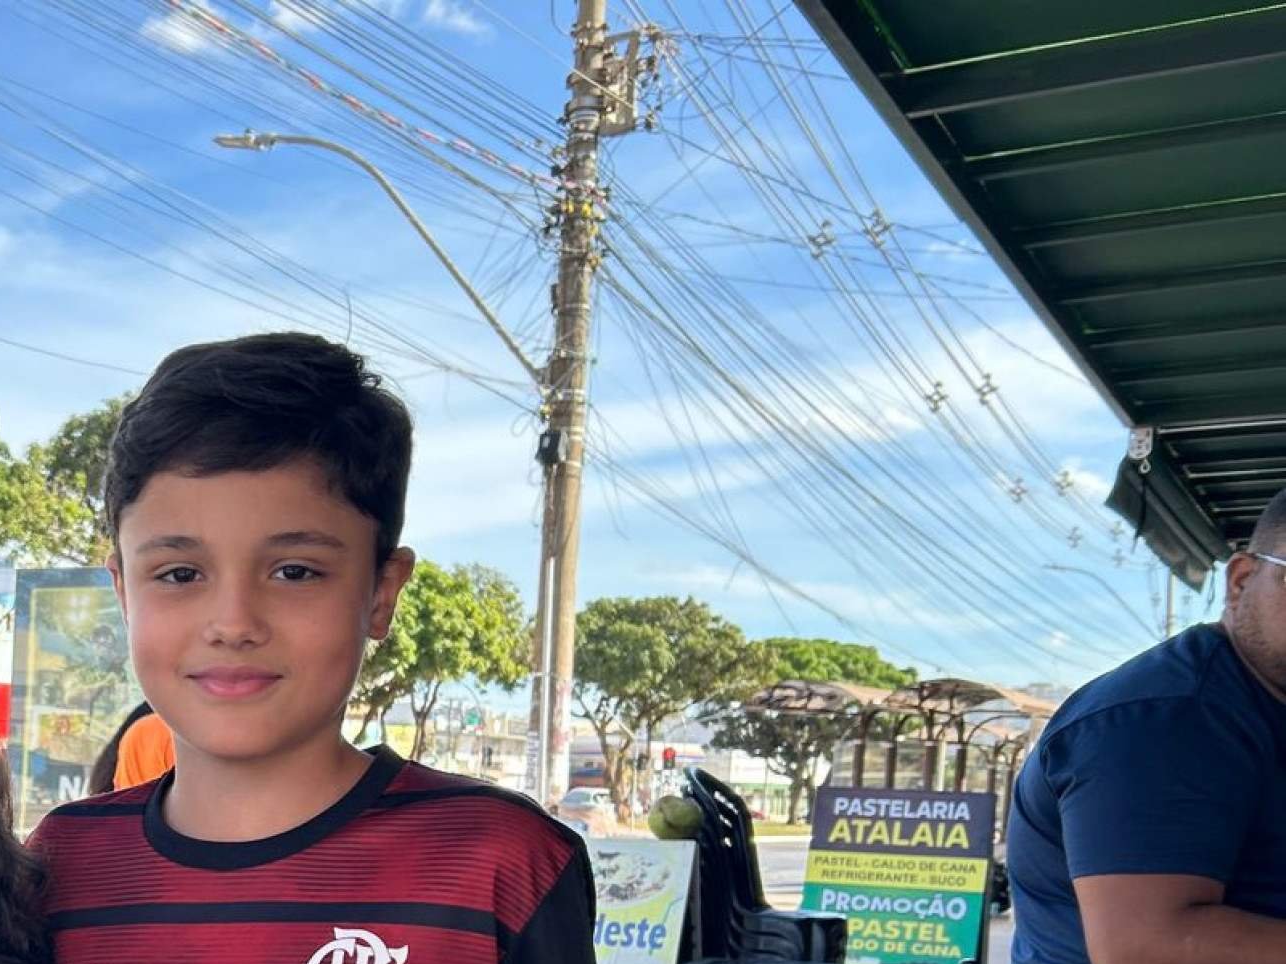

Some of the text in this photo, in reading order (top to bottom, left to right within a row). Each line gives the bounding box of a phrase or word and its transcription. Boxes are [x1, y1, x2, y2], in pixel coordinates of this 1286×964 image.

[833, 797, 970, 820] PASTELARIA
[828, 819, 969, 849] ATALAIA
[814, 855, 861, 867] PASTEL
[871, 858, 917, 871] CALDO
[918, 861, 937, 872] DE
[939, 862, 977, 875] CANA
[820, 869, 922, 884] REFRIGERANTE
[929, 874, 967, 887] SUCO
[820, 888, 968, 921] PROMOÇÃO
[847, 917, 951, 943] PASTEL
[847, 937, 962, 959] DO DE CANA
